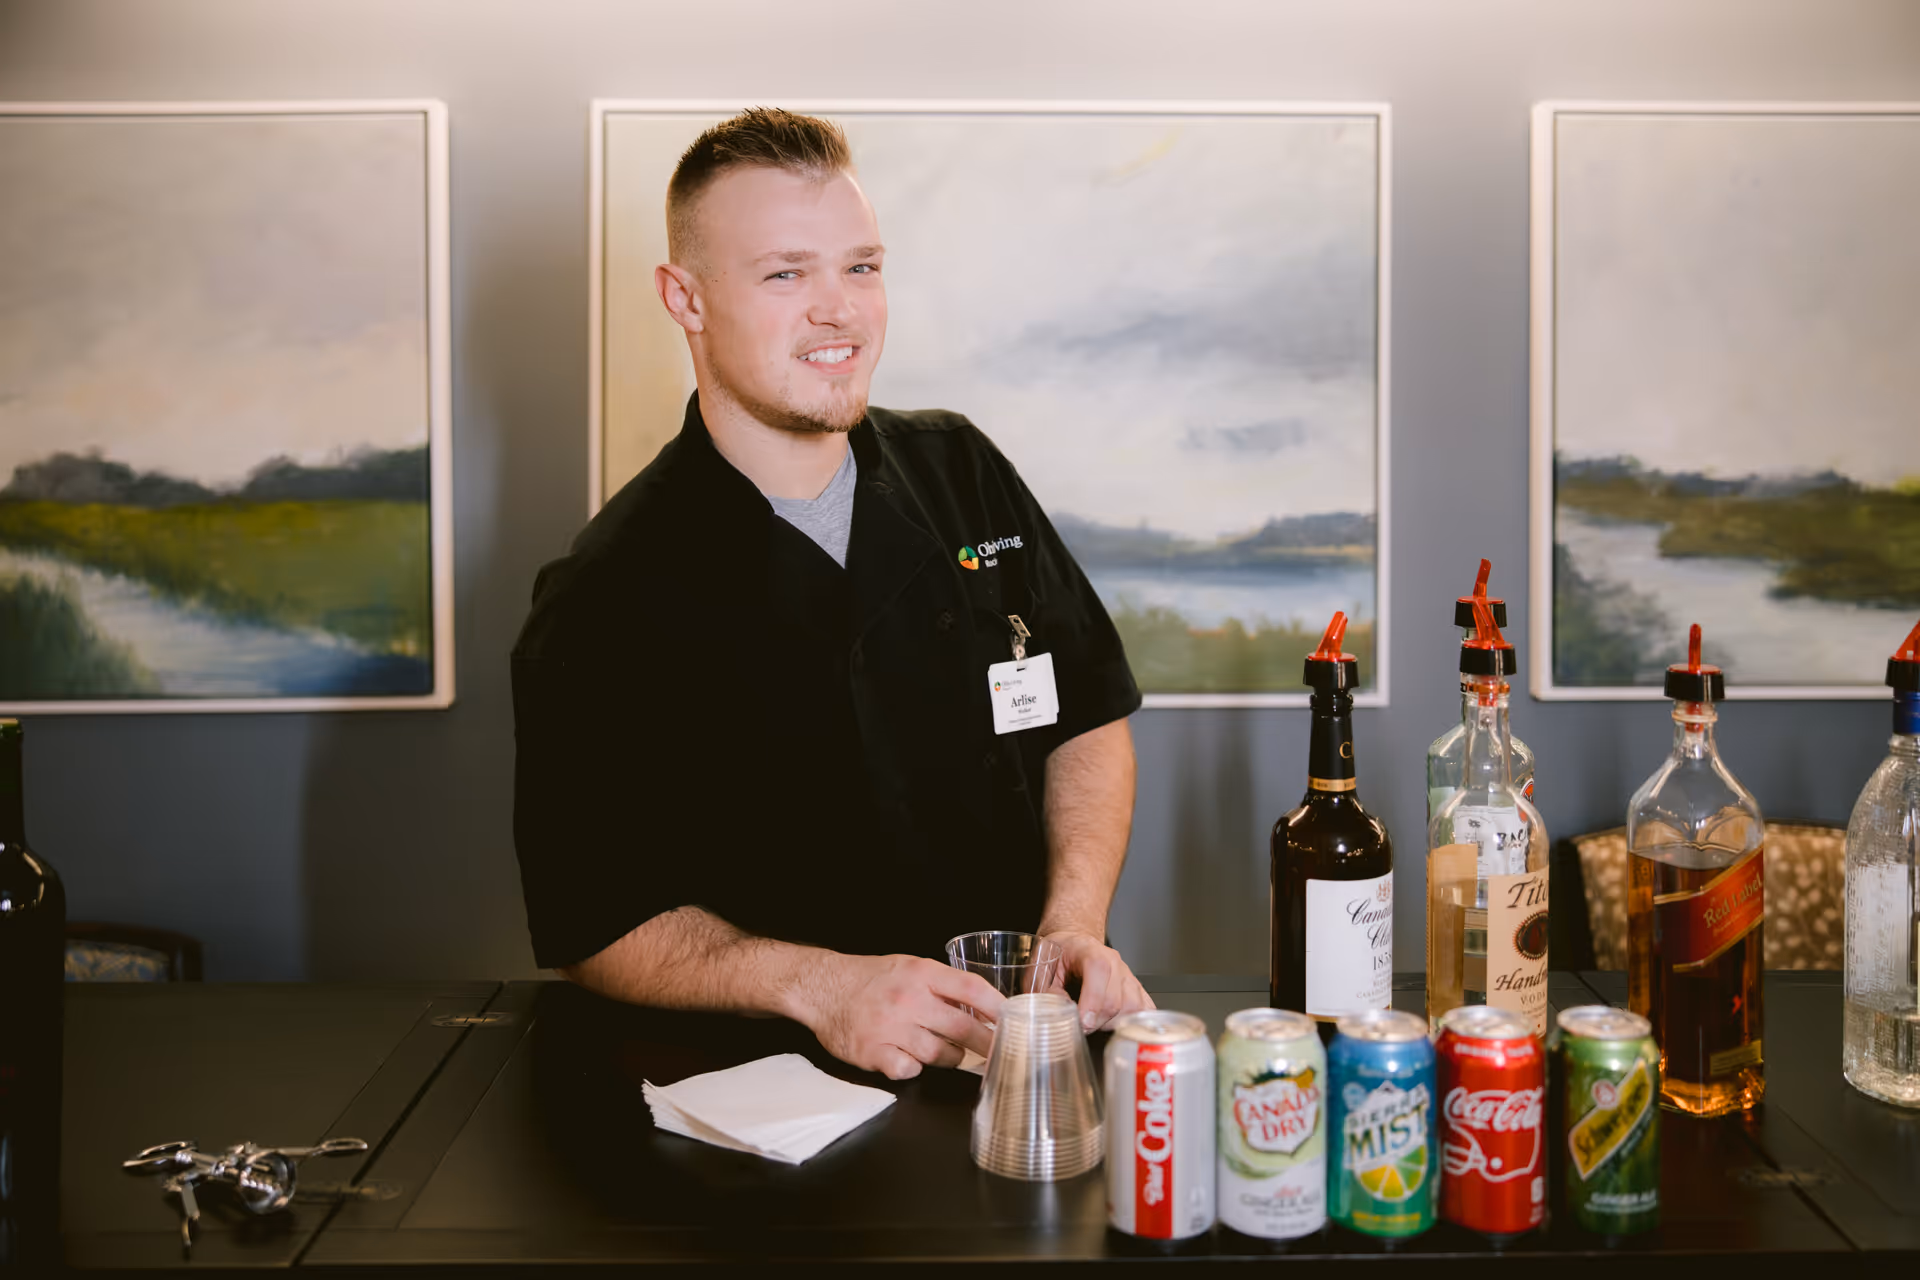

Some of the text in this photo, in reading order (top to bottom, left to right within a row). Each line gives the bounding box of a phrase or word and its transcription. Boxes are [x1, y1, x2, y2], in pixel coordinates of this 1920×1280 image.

[1011, 694, 1037, 708] Arlise
[1703, 897, 1730, 929] Red
[1731, 871, 1763, 908] Label
[1136, 1069, 1172, 1163] Coke
[1262, 1116, 1310, 1142] DRY
[1350, 1104, 1425, 1160] MIST
